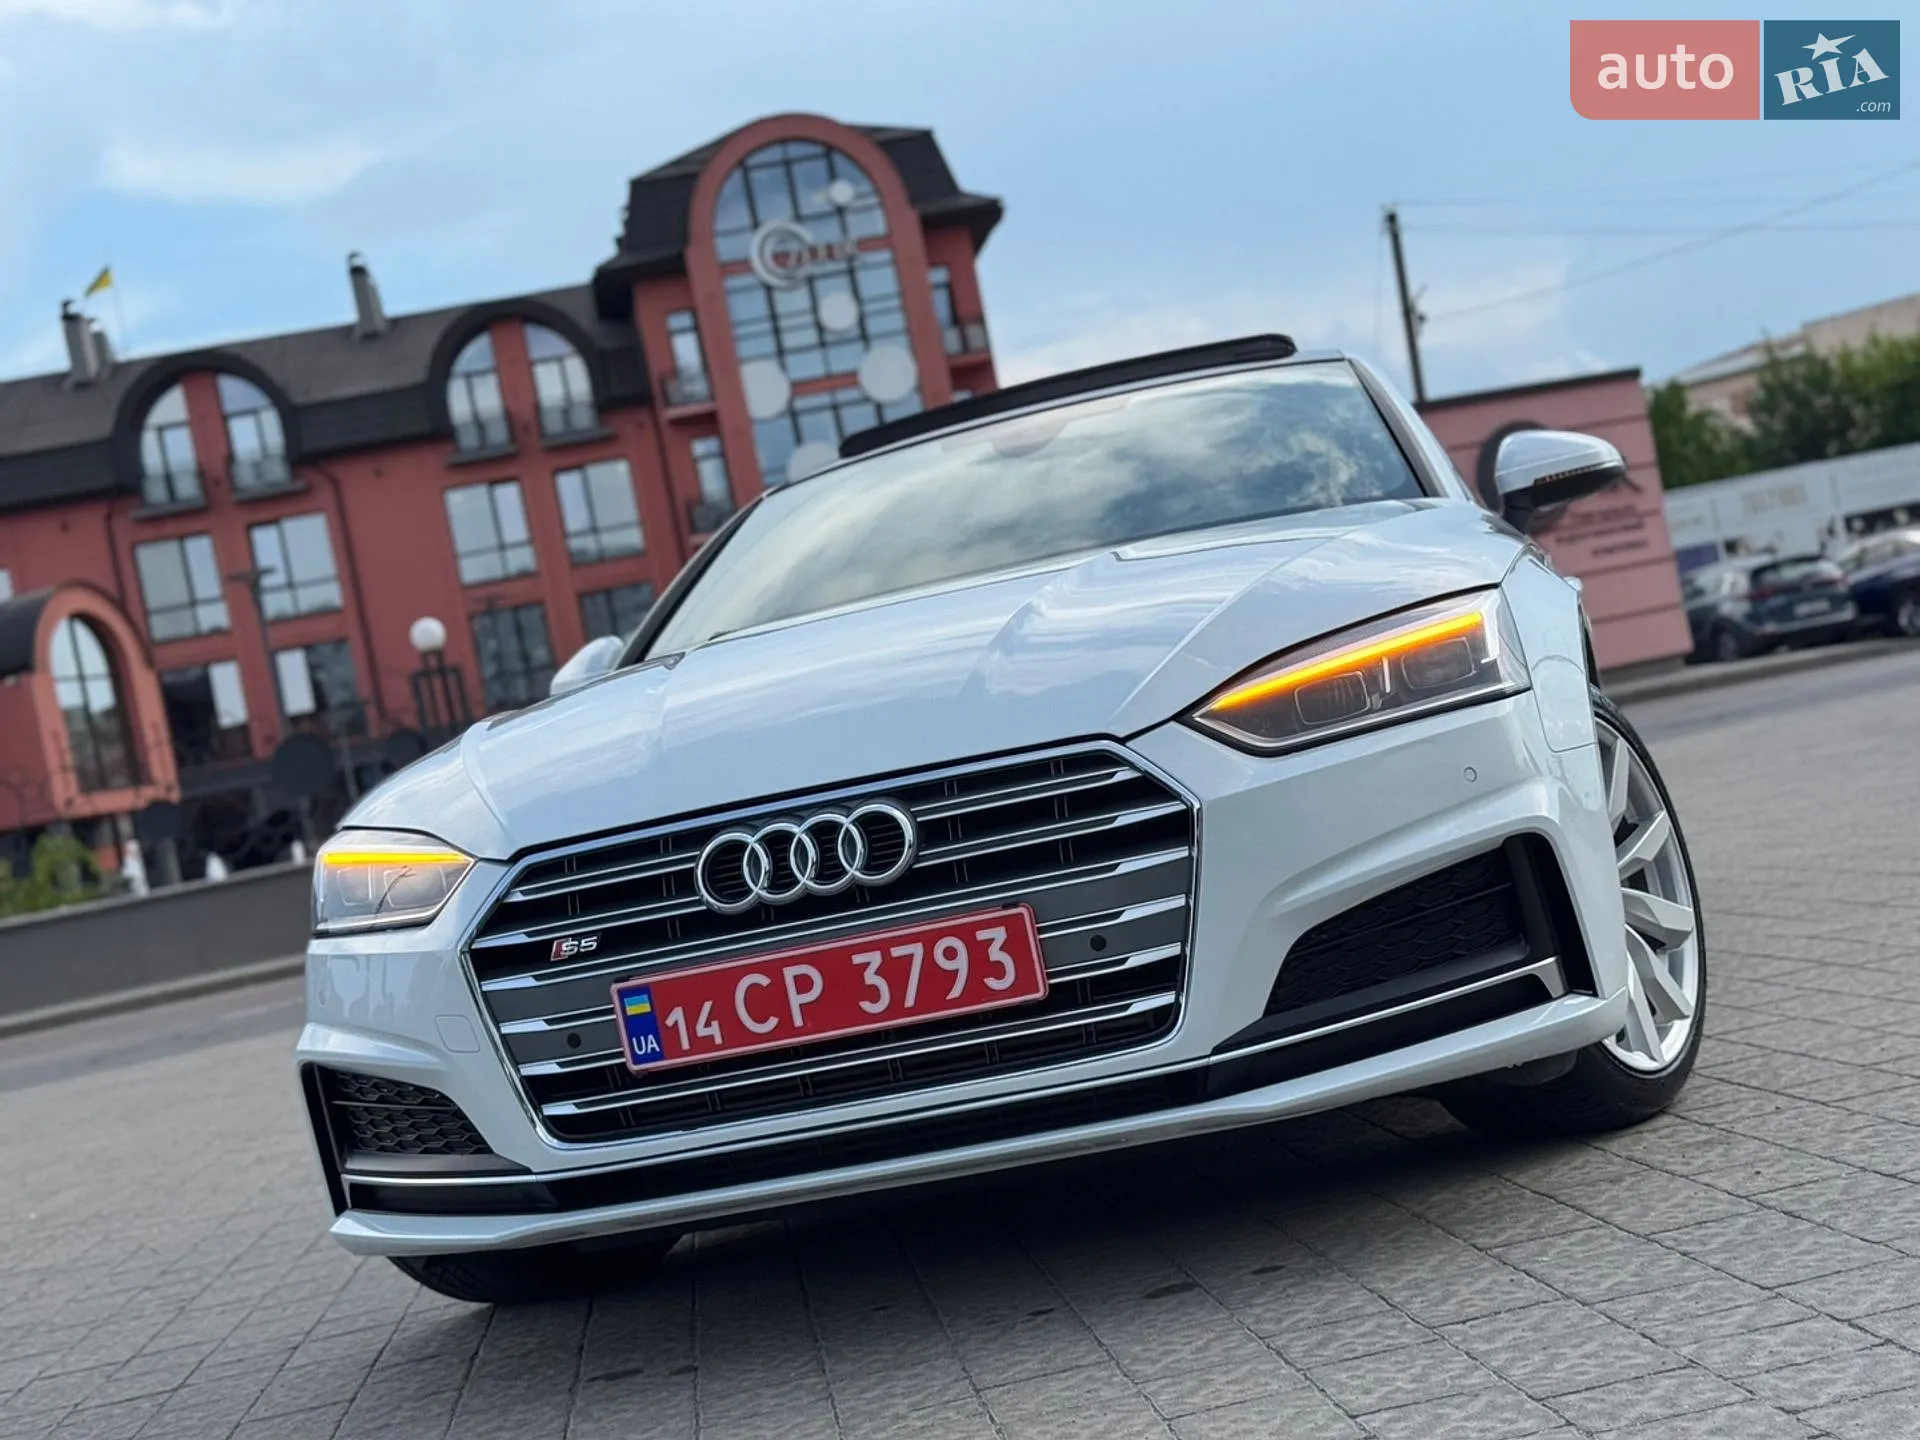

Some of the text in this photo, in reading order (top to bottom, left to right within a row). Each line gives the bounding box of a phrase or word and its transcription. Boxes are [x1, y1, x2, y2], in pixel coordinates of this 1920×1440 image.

[561, 936, 598, 956] S5
[665, 926, 1017, 1051] 14 CP 3793
[632, 1034, 661, 1056] UA
